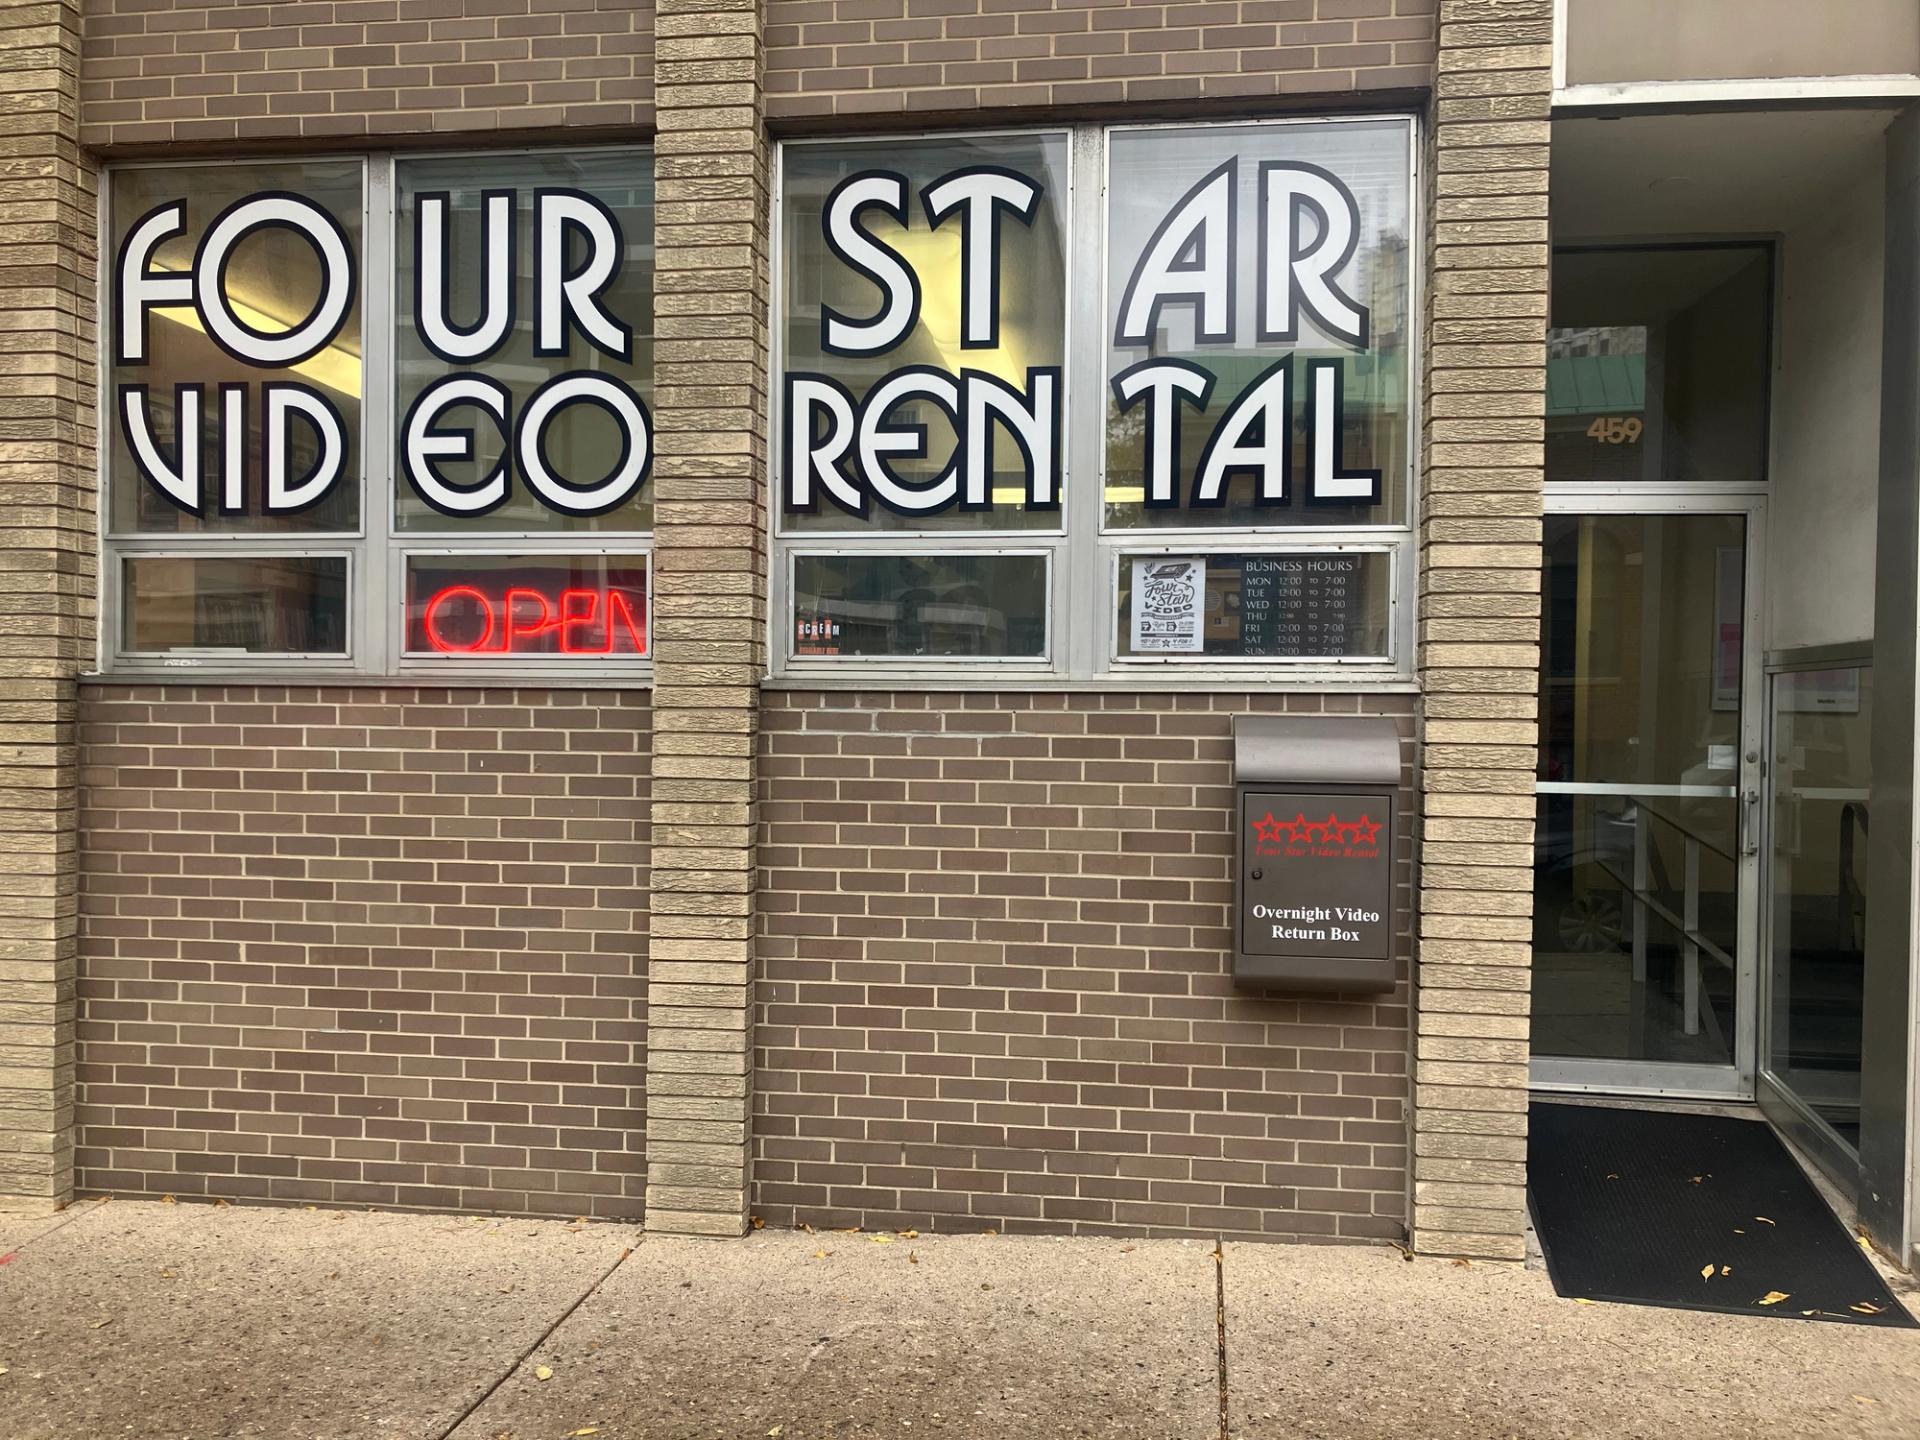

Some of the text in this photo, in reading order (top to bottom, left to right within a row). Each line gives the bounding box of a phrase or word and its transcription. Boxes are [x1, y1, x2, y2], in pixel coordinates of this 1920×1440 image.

[116, 155, 1369, 368] FOUR STAR
[118, 352, 1382, 520] VIDEO RENTAL
[1587, 417, 1643, 444] 459
[1246, 561, 1353, 572] BUSINESS HOURS
[1246, 577, 1271, 585] MON
[1279, 577, 1302, 585] 12:00
[1325, 576, 1346, 585] 7:00
[1144, 580, 1178, 598] Four
[1247, 589, 1265, 597] TUE
[1279, 589, 1302, 597] 12:00
[1324, 588, 1345, 597] 7:00
[1157, 592, 1191, 606] Star
[1246, 601, 1270, 609] WED
[1278, 601, 1302, 609] 12:00
[1324, 600, 1346, 608] 7:00
[1144, 601, 1193, 614] VIDEO
[425, 586, 646, 653] OPEN
[1247, 613, 1267, 621] THU
[798, 623, 840, 636] SCREAM
[1245, 624, 1260, 632] FRI
[1278, 624, 1301, 632] 12:00
[1323, 624, 1344, 632] 7:00
[1245, 636, 1262, 644] SAT
[1278, 635, 1300, 644] 12:00
[1323, 635, 1344, 643] 7:00
[1245, 647, 1265, 655] SUN
[1278, 647, 1300, 655] 12:00
[1322, 647, 1343, 655] 7:00
[1253, 904, 1380, 923] Overnight Video
[1272, 925, 1360, 941] Return Box
